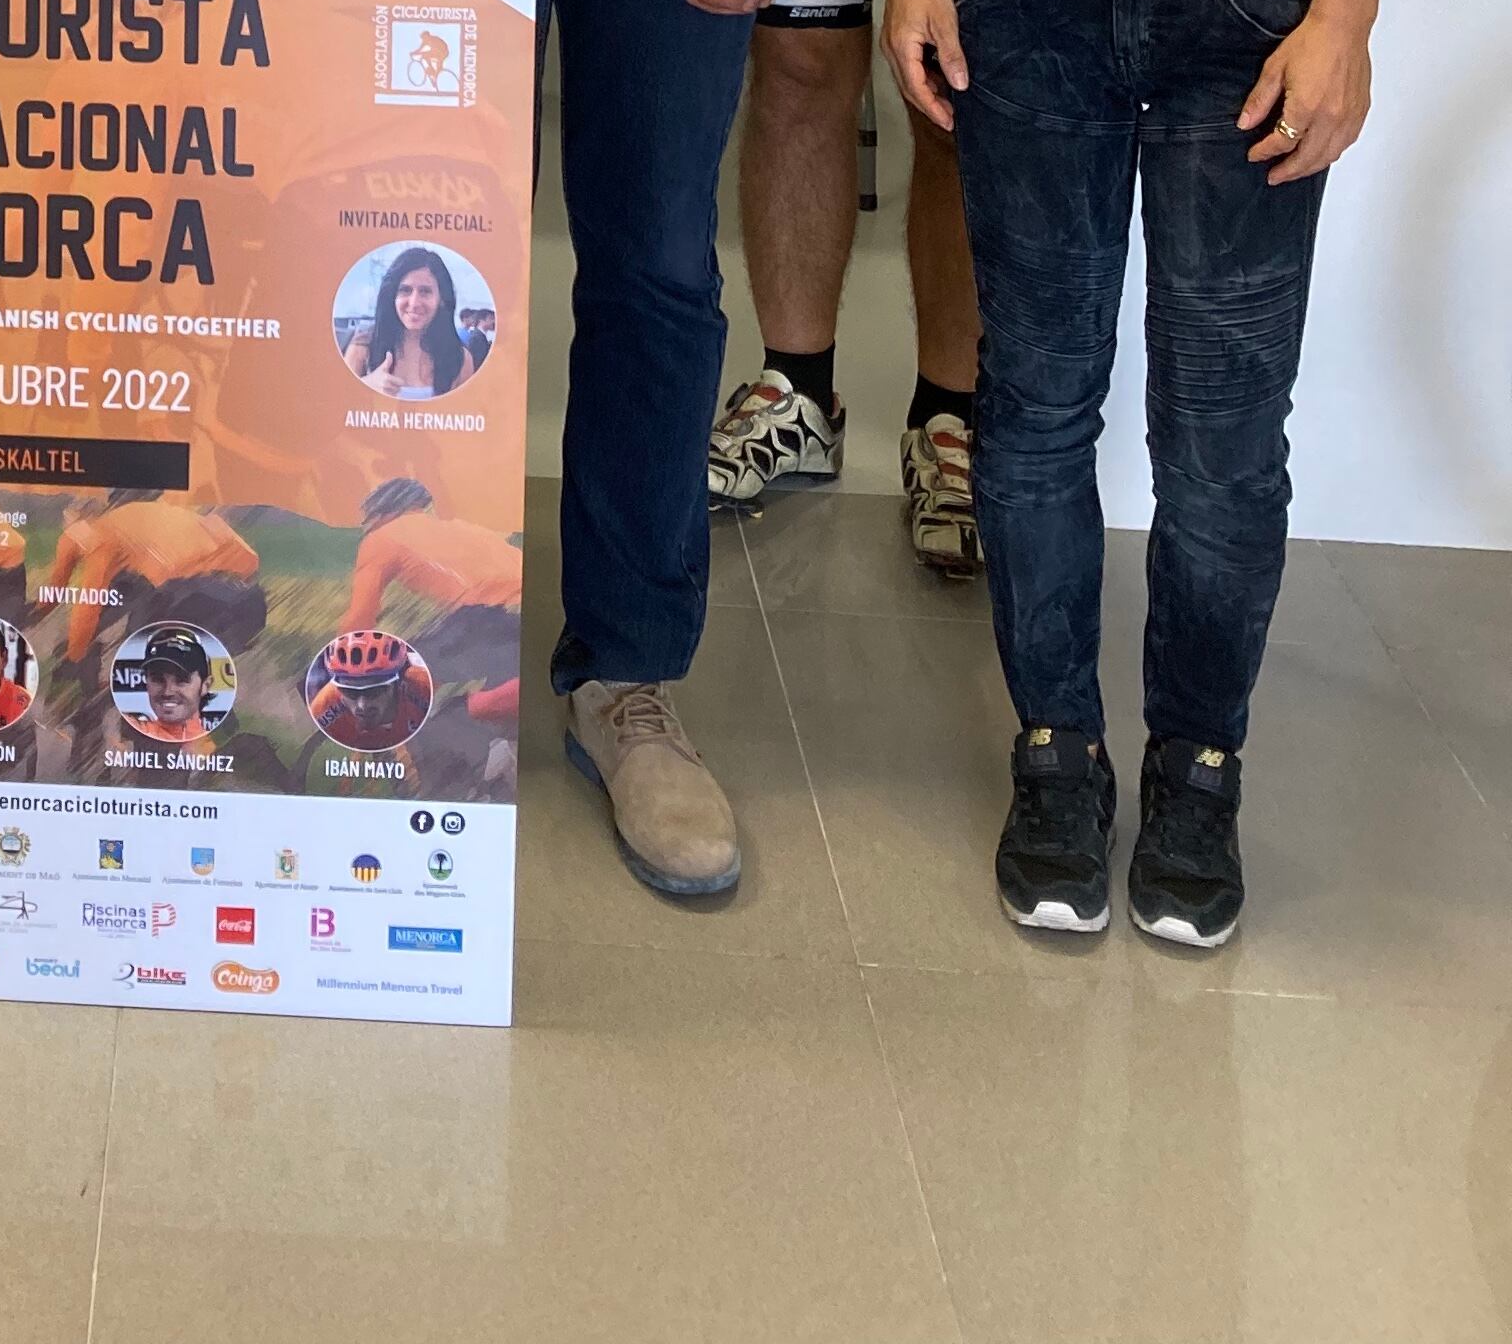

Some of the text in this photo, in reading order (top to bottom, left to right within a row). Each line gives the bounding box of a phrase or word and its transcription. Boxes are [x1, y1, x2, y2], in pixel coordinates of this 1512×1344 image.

[392, 5, 477, 21] CICLOTURISTA
[374, 4, 388, 89] ASOCIACIÓN
[463, 23, 477, 108] DE MENORCA
[339, 210, 493, 233] INVITADA ESPECIAL:
[64, 311, 159, 334] CYCLING
[163, 314, 282, 340] TOGETHER
[101, 369, 192, 413] 2022
[345, 410, 486, 433] AINARA HERNANDO
[38, 583, 125, 608] INVITADOS:
[105, 750, 234, 773] SAMUEL SÁNCHEZ
[325, 757, 405, 779] IBÁN MAYO
[82, 903, 146, 918] Piscinas
[82, 915, 147, 930] Menorca
[395, 929, 457, 945] MENORCA
[217, 968, 274, 993] Coinga
[317, 977, 463, 996] Millennium Menorca Travel
